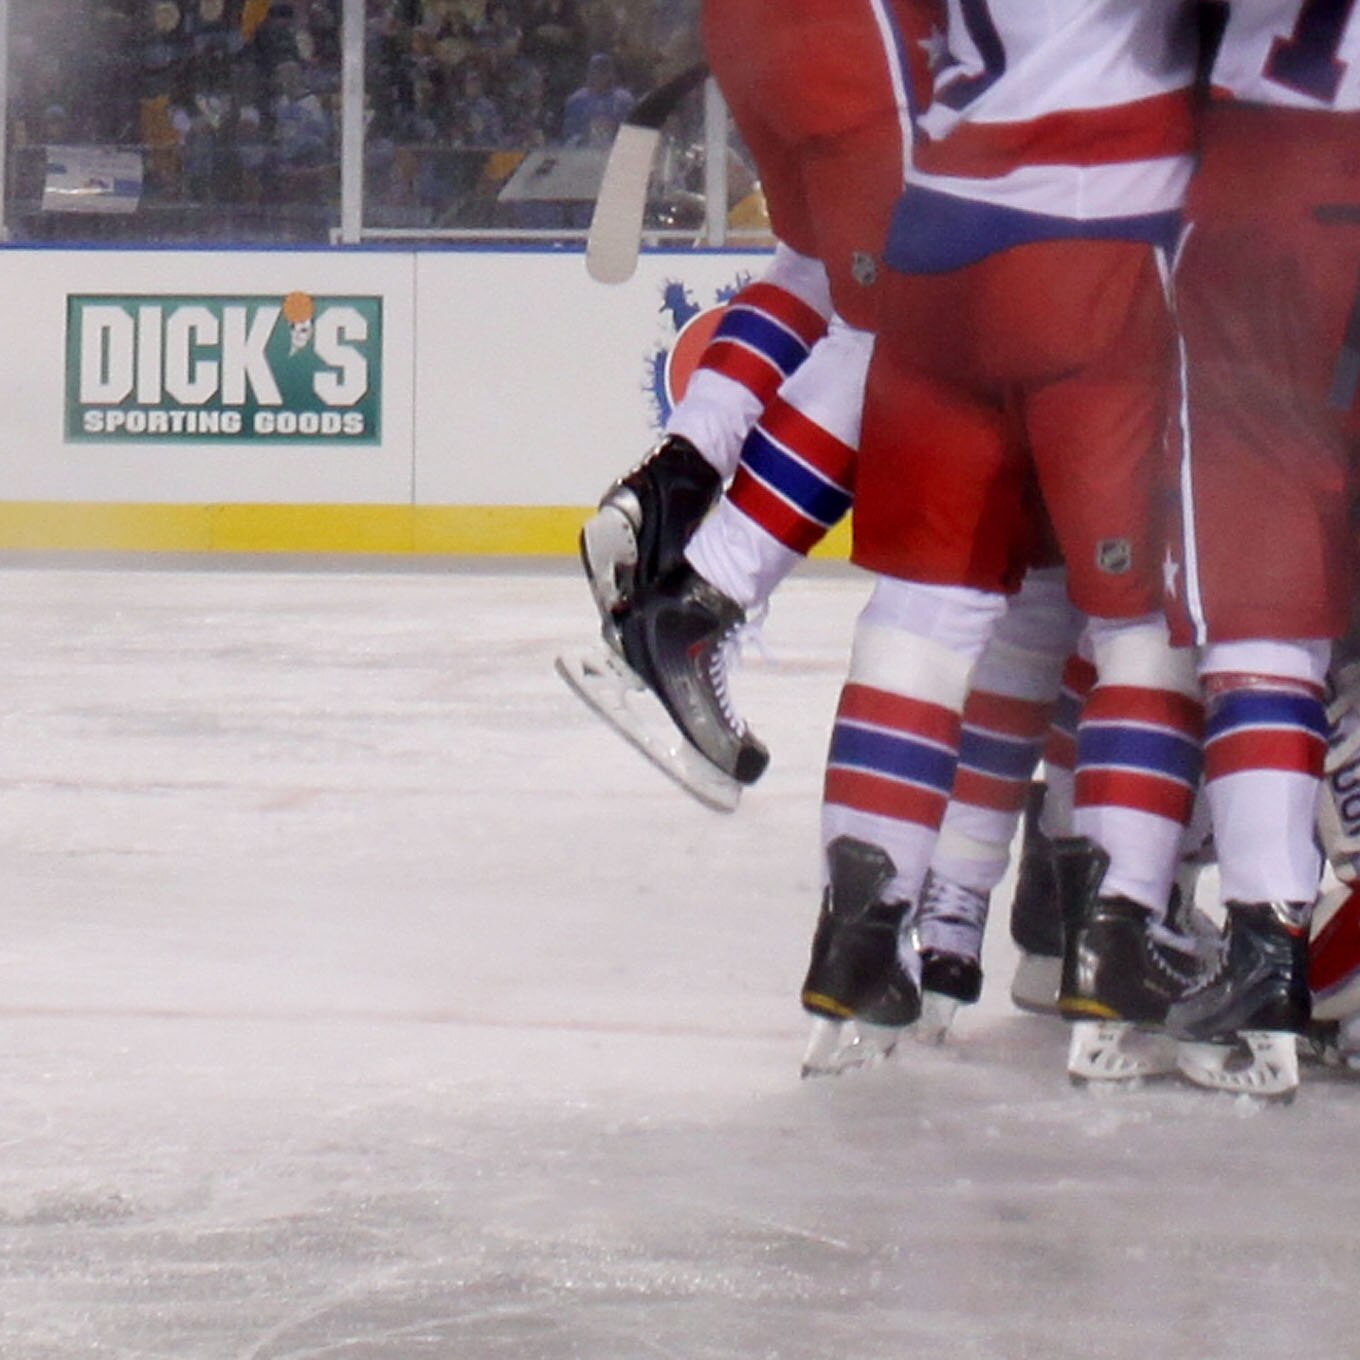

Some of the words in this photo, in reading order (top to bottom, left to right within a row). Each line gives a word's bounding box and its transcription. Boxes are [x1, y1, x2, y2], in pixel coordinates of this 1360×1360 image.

[79, 302, 368, 406] DICK'S
[83, 410, 242, 434] SPORTING
[253, 411, 364, 435] GOODS
